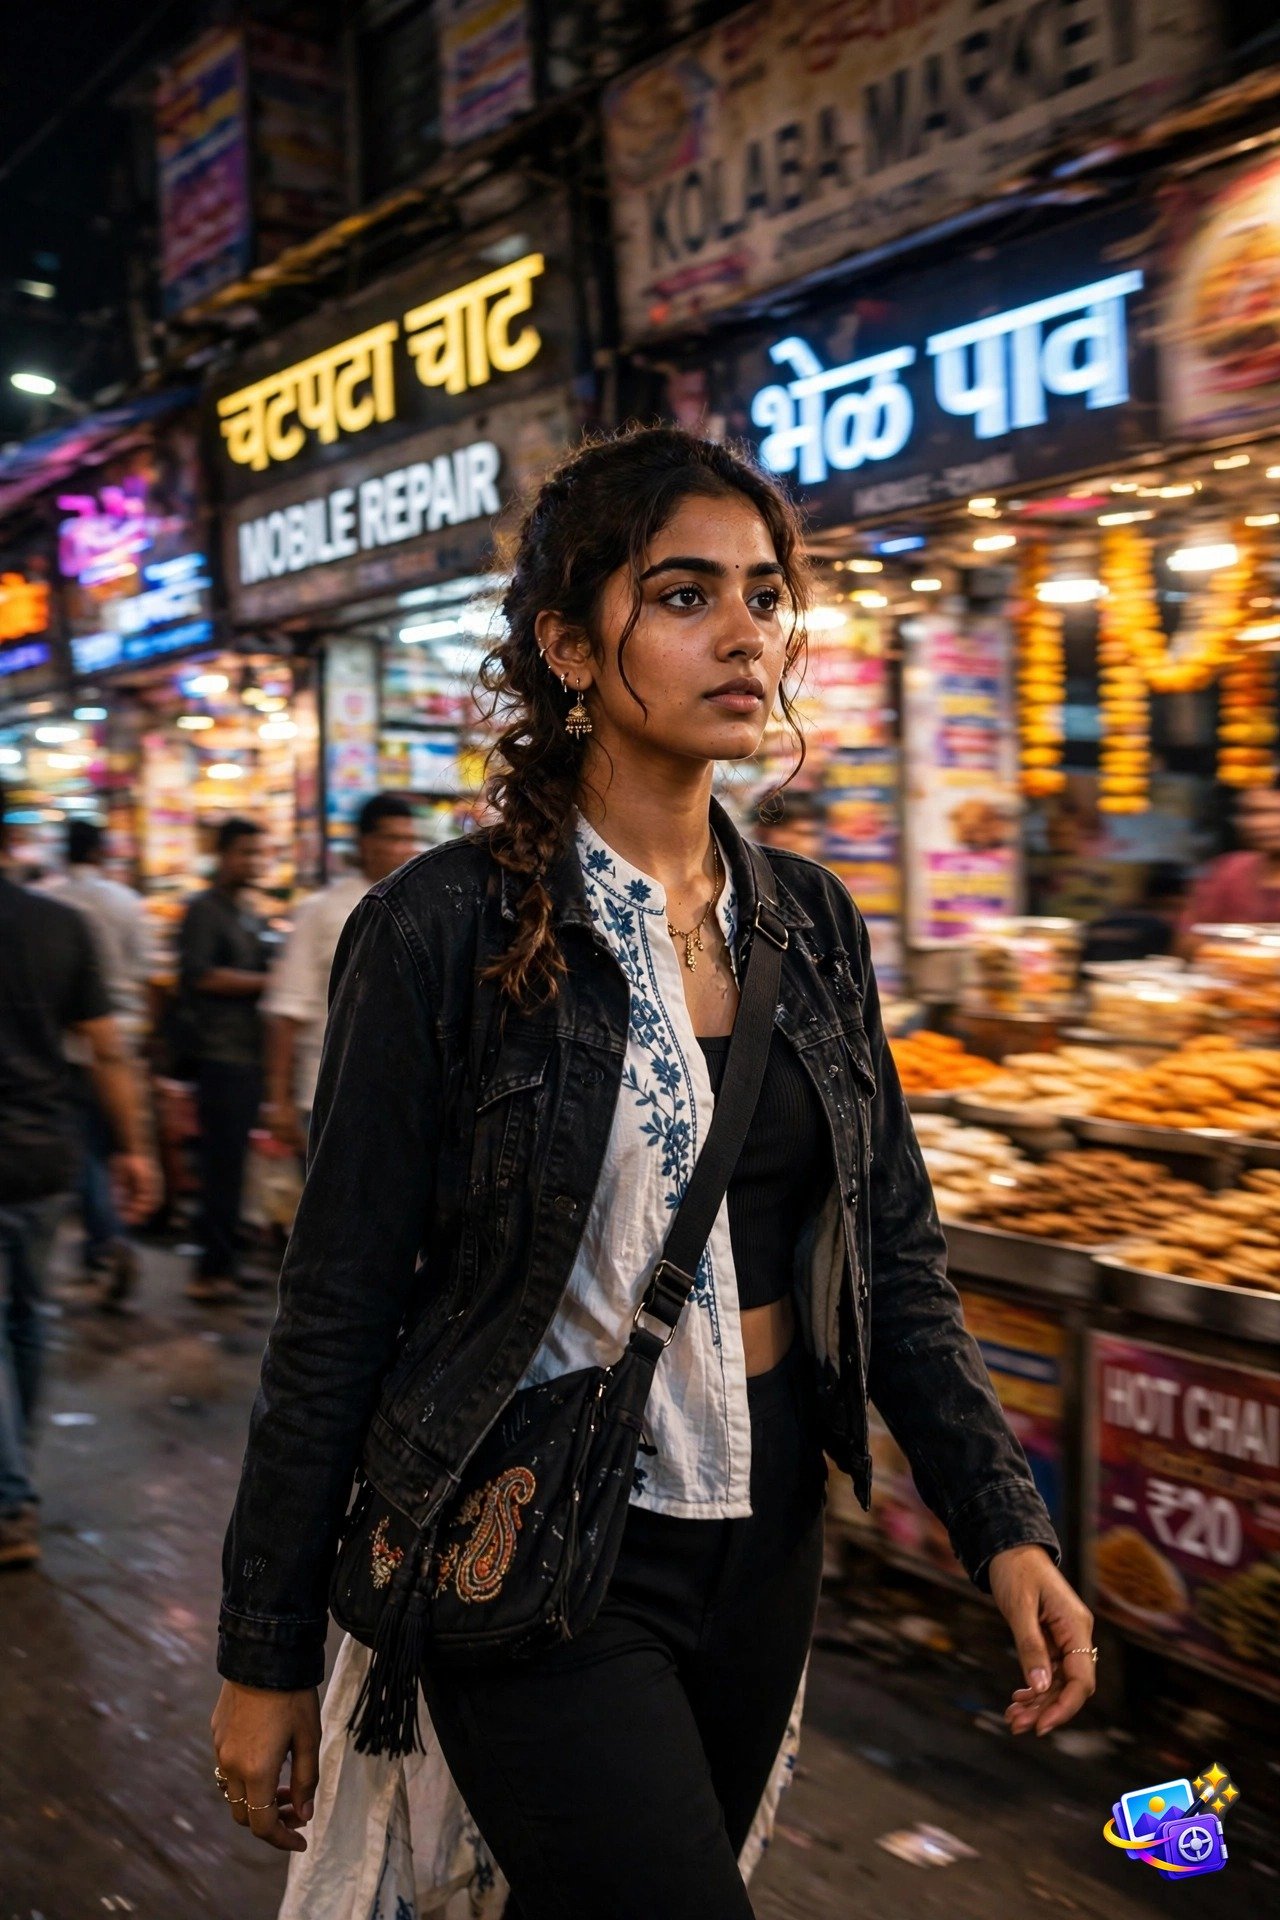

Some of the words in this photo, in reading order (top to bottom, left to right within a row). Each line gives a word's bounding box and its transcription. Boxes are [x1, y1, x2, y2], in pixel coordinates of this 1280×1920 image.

[648, 105, 853, 270] KOLABA
[216, 319, 399, 472] चटपटा
[403, 252, 546, 395] चाट
[750, 336, 917, 485] भेळ
[925, 269, 1145, 440] पाव
[238, 488, 357, 586] MOBILE
[359, 440, 501, 550] REPAIR
[1103, 1363, 1182, 1440] HOT
[1145, 1477, 1243, 1568] ₹20
